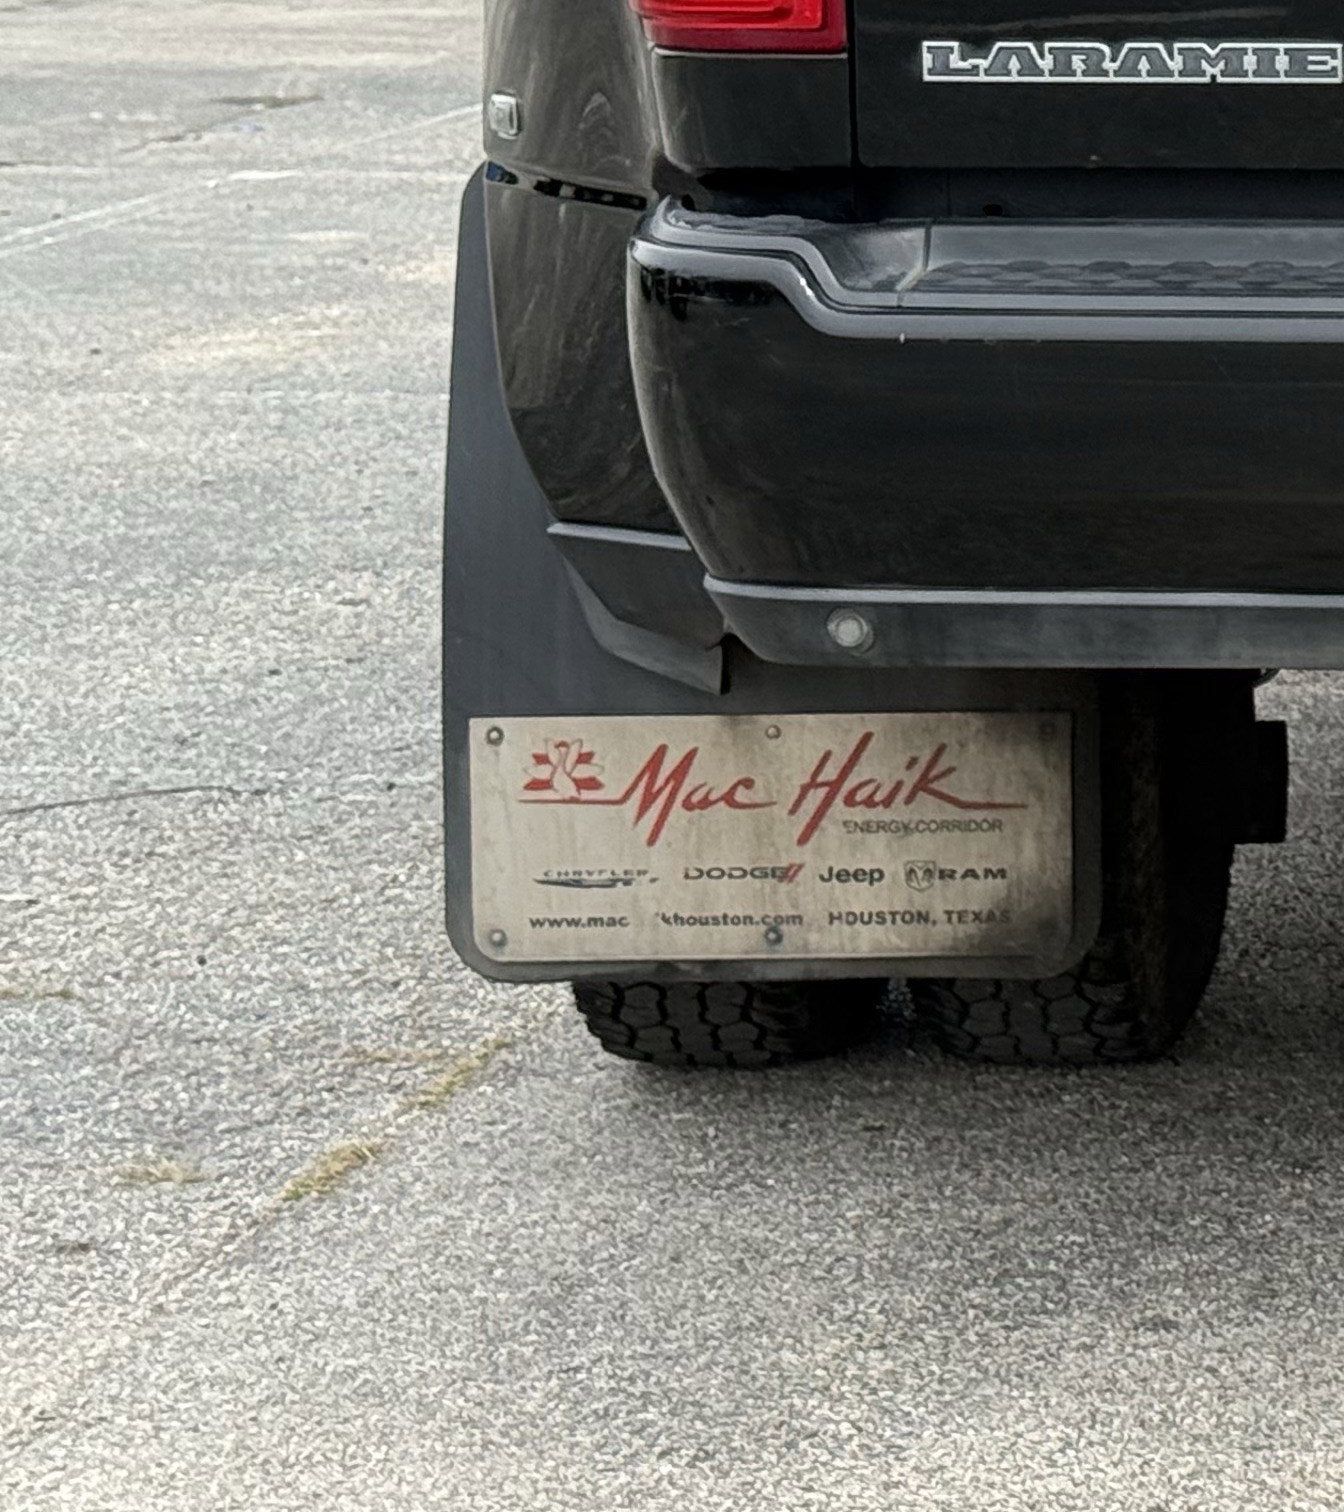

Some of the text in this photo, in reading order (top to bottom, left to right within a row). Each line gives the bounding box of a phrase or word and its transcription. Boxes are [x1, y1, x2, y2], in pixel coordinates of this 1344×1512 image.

[922, 40, 1344, 84] LARAMIE
[518, 731, 1029, 847] Mac Haik
[682, 865, 788, 881] DODGE
[818, 865, 886, 887] Jeep
[937, 866, 1009, 882] RAM
[828, 909, 938, 927] HOUSTON,
[943, 908, 1012, 926] TEXAS
